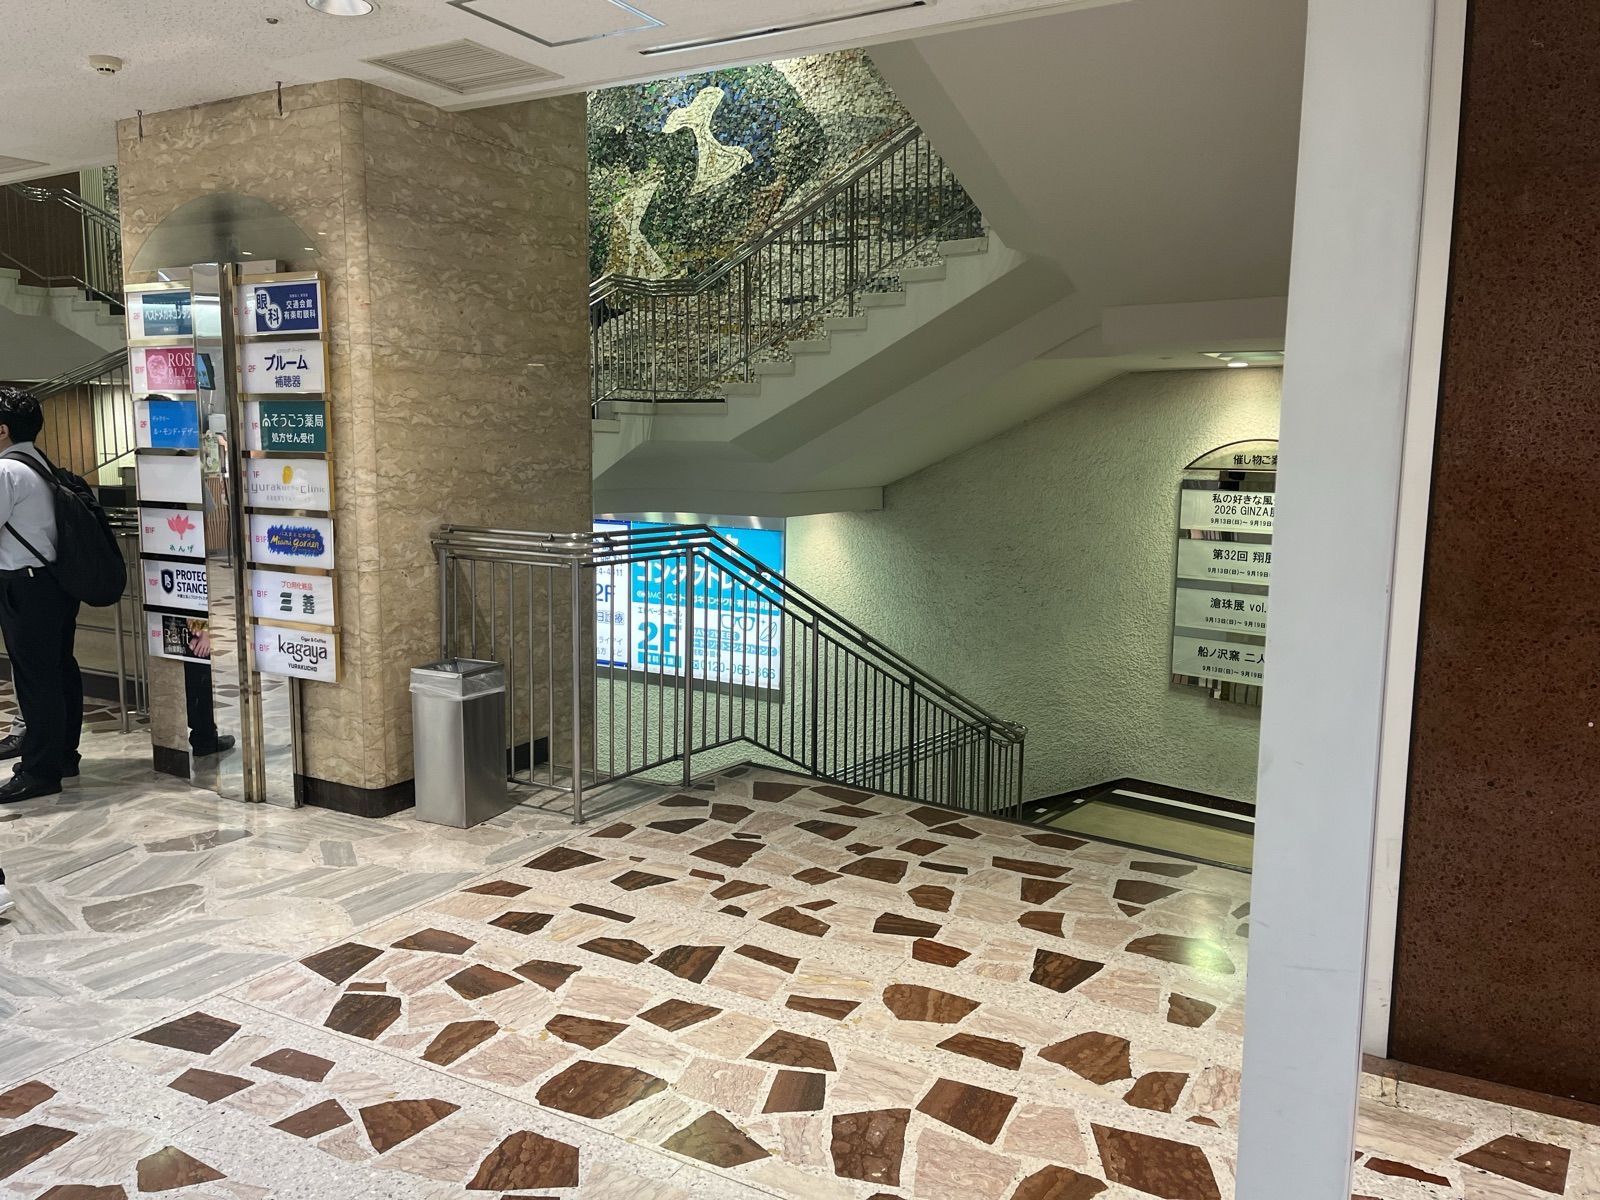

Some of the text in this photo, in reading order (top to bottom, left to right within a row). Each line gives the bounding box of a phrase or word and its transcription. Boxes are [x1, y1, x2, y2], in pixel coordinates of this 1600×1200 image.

[286, 299, 313, 310] 交通会館
[283, 309, 316, 320] 有楽町眼科
[168, 367, 196, 378] PLAZ
[248, 364, 256, 373] 2F
[274, 375, 301, 388] 補聴器
[252, 422, 259, 430] 1F
[271, 413, 324, 428] そうごう薬局
[271, 432, 315, 444] 処方せん受付
[252, 470, 260, 479] 1F
[1212, 493, 1275, 505] 私の好きな風
[1214, 504, 1237, 515] 2026
[145, 526, 155, 534] B1F
[256, 535, 267, 543] B1F
[1212, 548, 1248, 562] 第32回
[176, 581, 208, 595] STANCE
[596, 583, 615, 603] 2F
[256, 590, 268, 598] B1F
[1249, 602, 1267, 613] vol.
[638, 621, 680, 653] 2F
[277, 634, 328, 664] kagaya
[1244, 653, 1265, 664] 二人
[288, 662, 318, 672] YURAKUCHO
